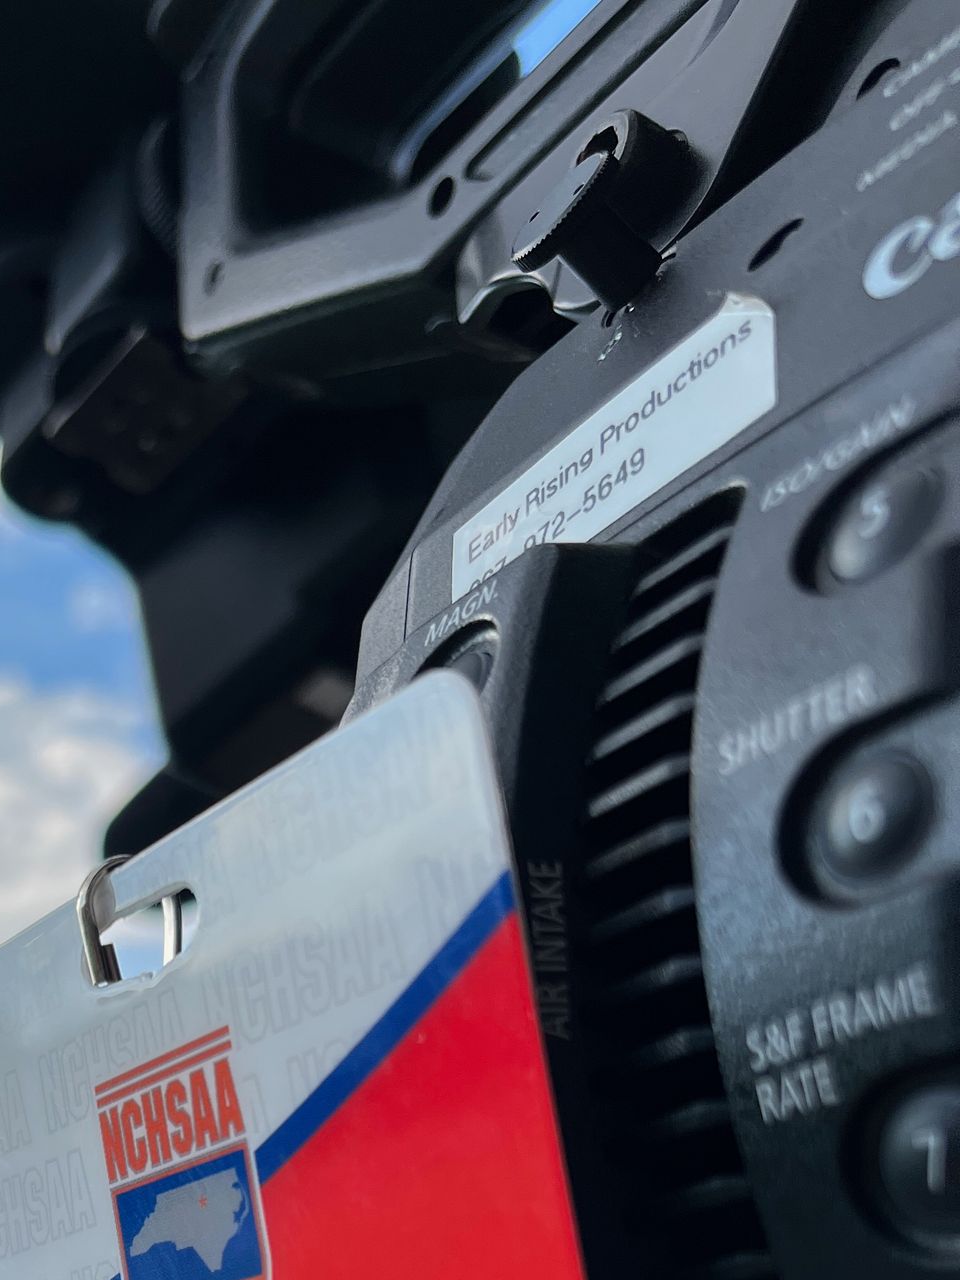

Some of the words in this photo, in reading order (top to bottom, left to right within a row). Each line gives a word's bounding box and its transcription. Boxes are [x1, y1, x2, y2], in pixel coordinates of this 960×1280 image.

[469, 507, 521, 564] Early
[526, 448, 594, 518] Rising
[600, 319, 752, 456] Productions
[425, 580, 498, 646] MAGN.
[719, 664, 878, 776] SHUTTER
[848, 778, 886, 844] 6
[527, 858, 567, 972] INTAKE
[746, 1012, 804, 1074] S&F
[811, 966, 938, 1048] FRAME
[99, 1057, 246, 1185] NCHSAA
[755, 1058, 838, 1124] RATE
